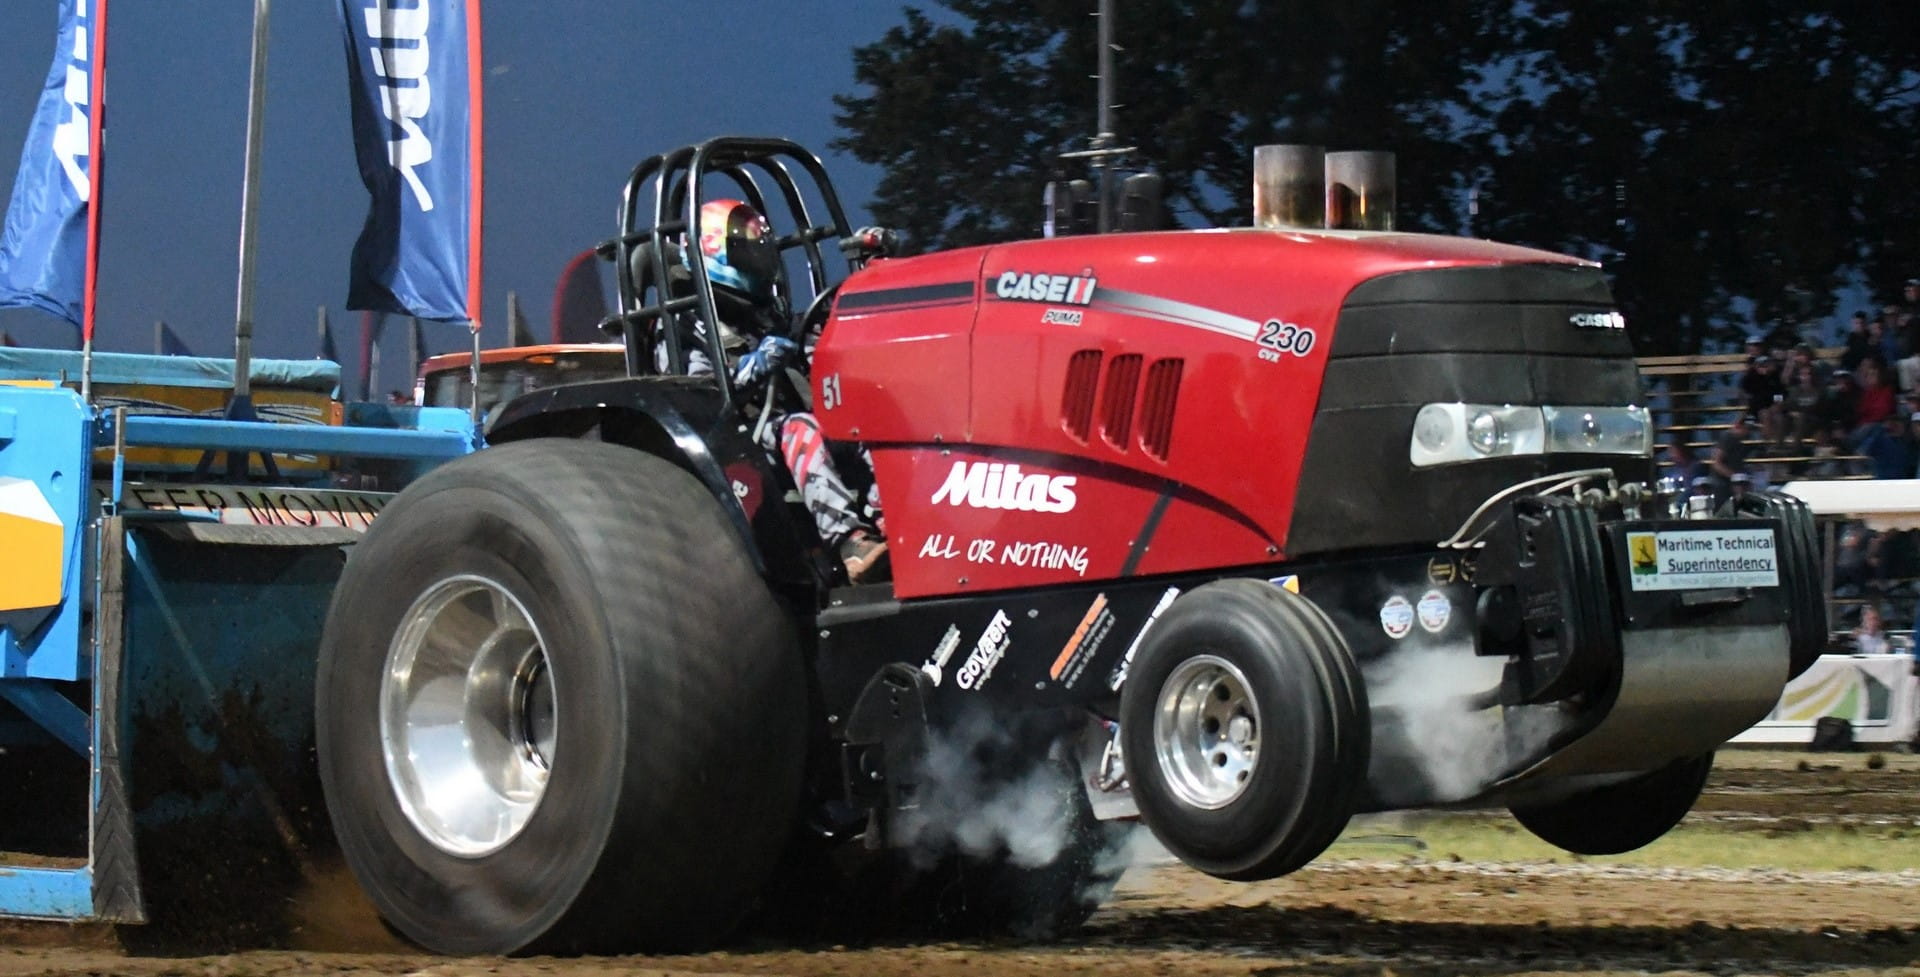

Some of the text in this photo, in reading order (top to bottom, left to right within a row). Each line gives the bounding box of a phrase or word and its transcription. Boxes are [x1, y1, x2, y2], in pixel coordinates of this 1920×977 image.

[1041, 308, 1083, 327] PUMA
[1257, 318, 1316, 356] 230
[1258, 347, 1281, 364] CVX
[822, 372, 842, 410] 51
[931, 461, 1078, 513] Mitas
[918, 533, 1089, 577] ALL OR NOTHING
[1658, 535, 1774, 552] Maritime Technical
[1667, 556, 1772, 573] Superintendency
